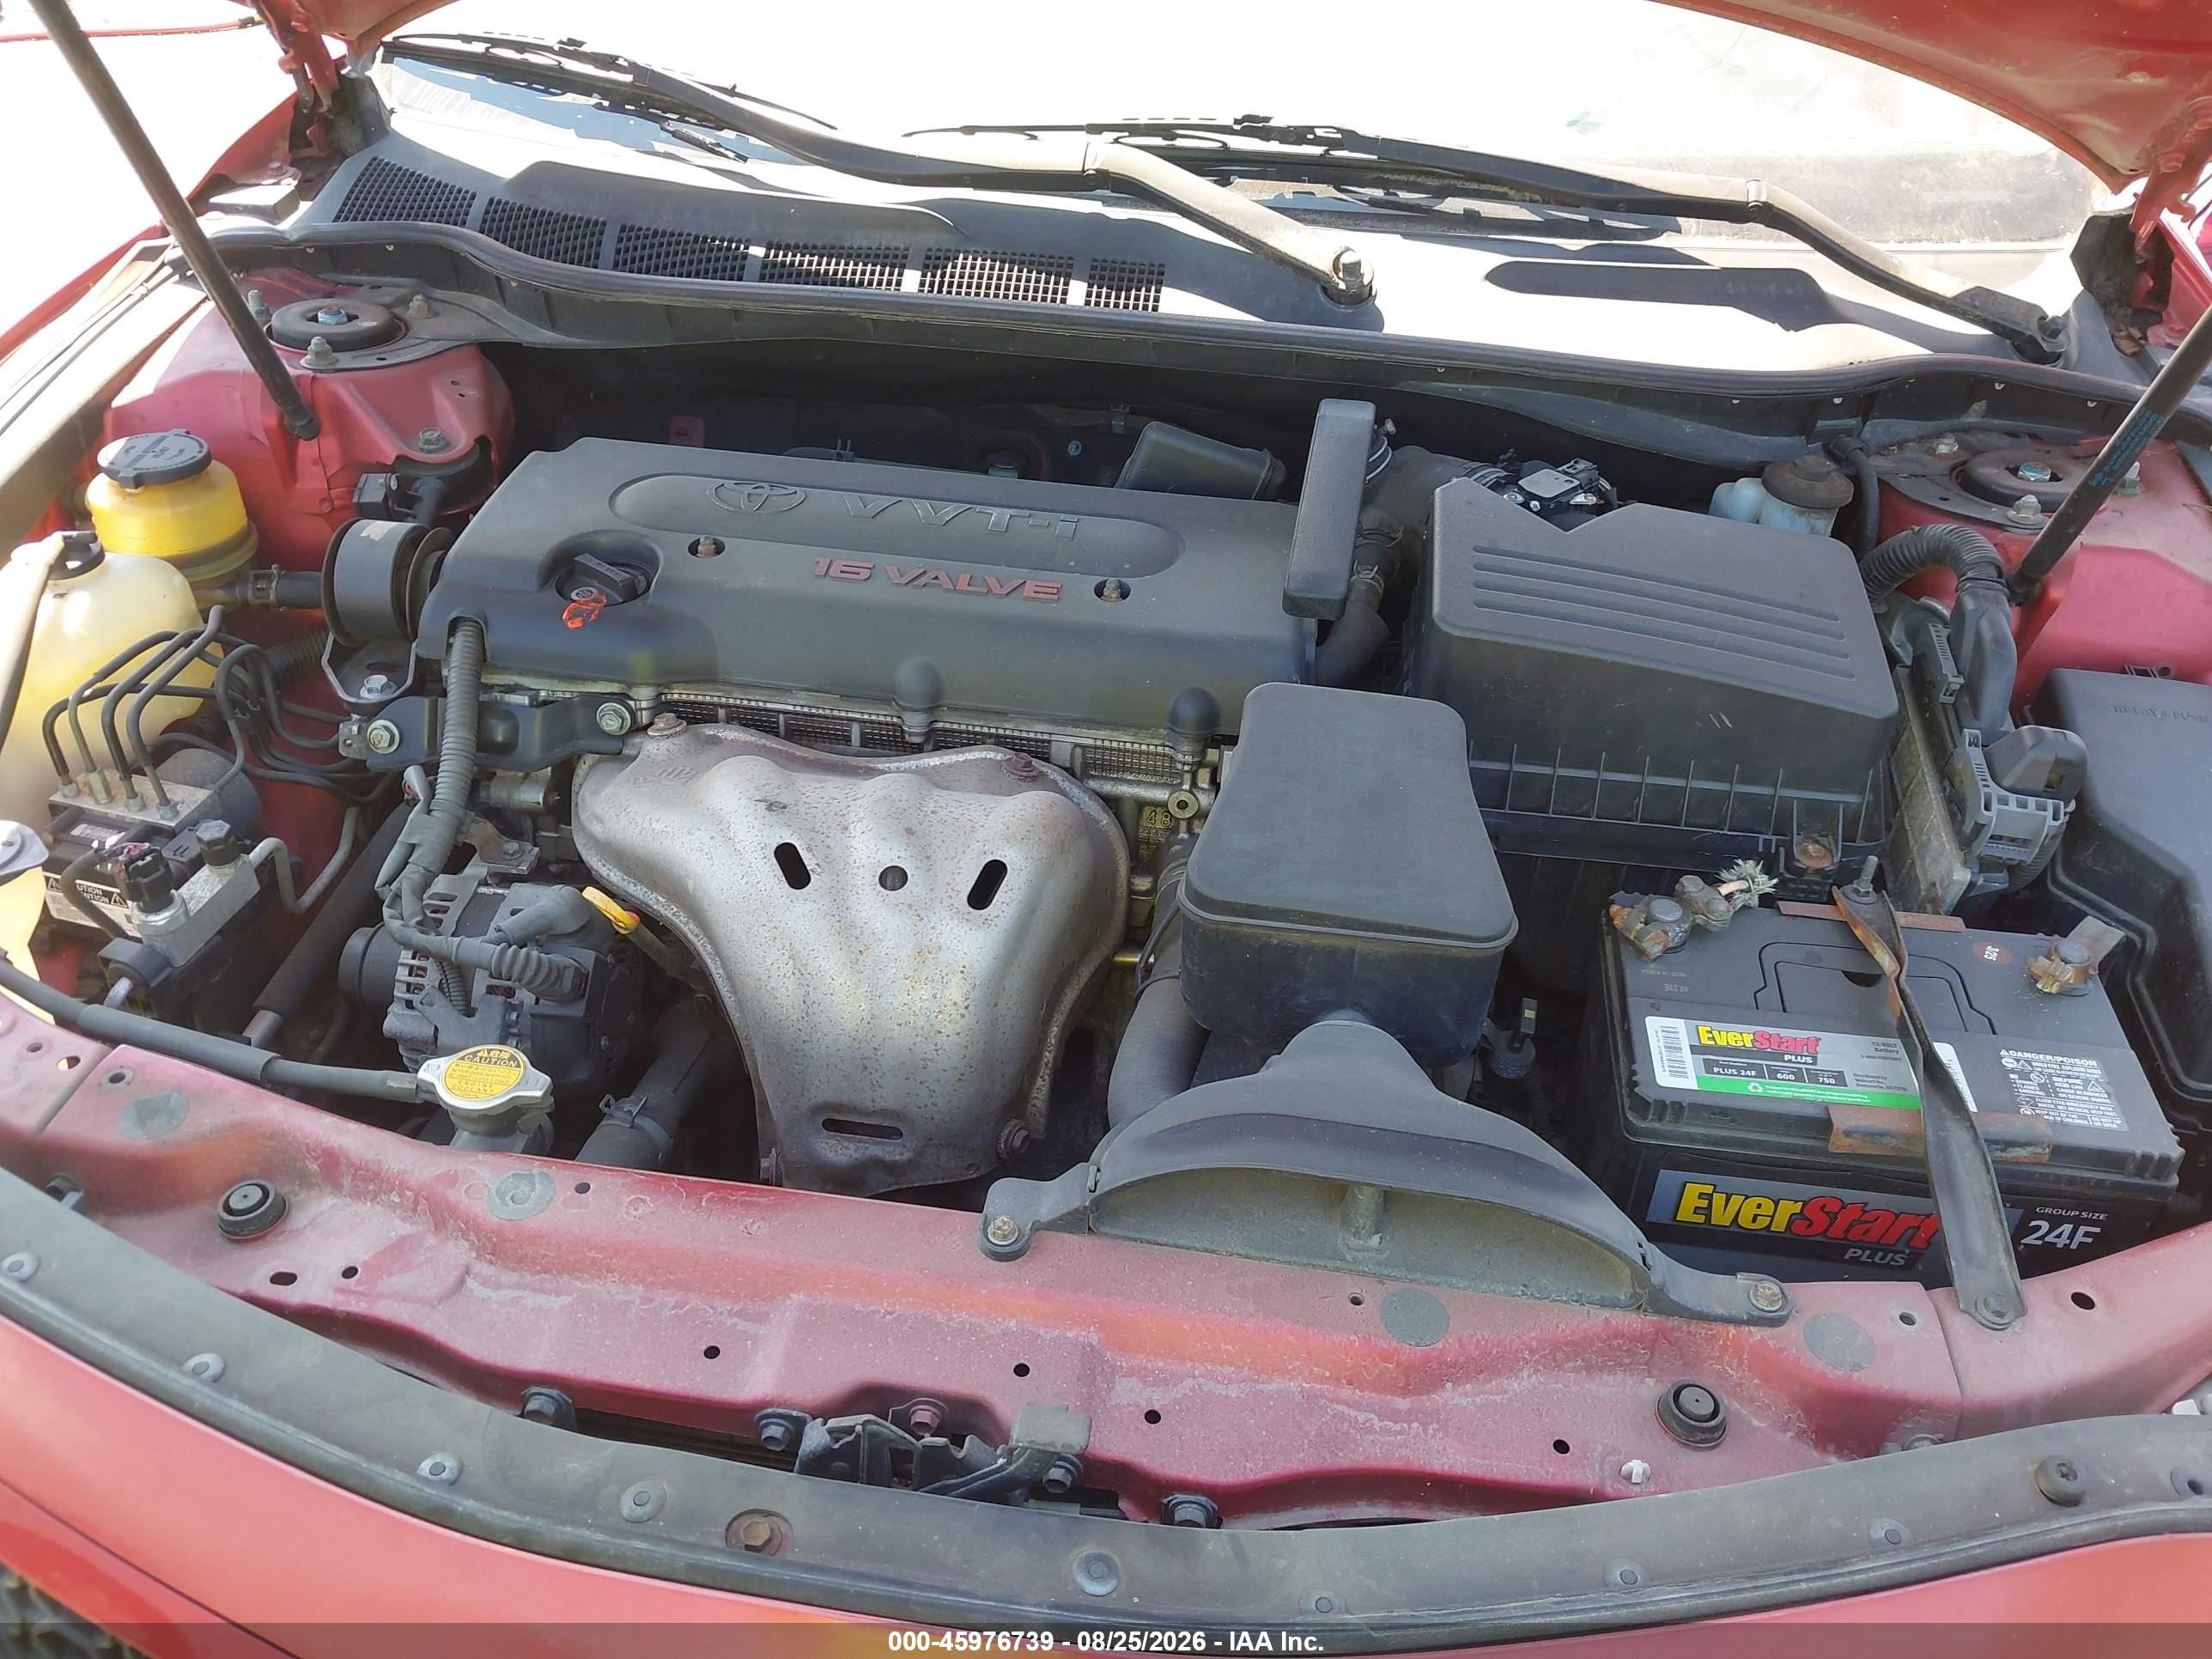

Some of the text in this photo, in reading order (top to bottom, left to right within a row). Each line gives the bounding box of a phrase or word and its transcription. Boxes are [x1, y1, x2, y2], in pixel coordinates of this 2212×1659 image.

[814, 558, 1063, 601] 16 VALVE
[1146, 810, 1172, 828] 48
[76, 884, 103, 896] UTION
[82, 891, 110, 903] NTION
[1697, 1025, 1820, 1054] EverStart
[464, 1054, 518, 1067] CAUTION
[1784, 1054, 1814, 1064] PLUS
[2008, 1049, 2098, 1066] DANGER/POISON
[1713, 1066, 1737, 1075] PLUS
[1674, 1182, 1940, 1249] EverStart
[2035, 1206, 2109, 1221] GROUP SIZE
[2021, 1220, 2102, 1250] 24F
[1843, 1247, 1909, 1267] PLUS
